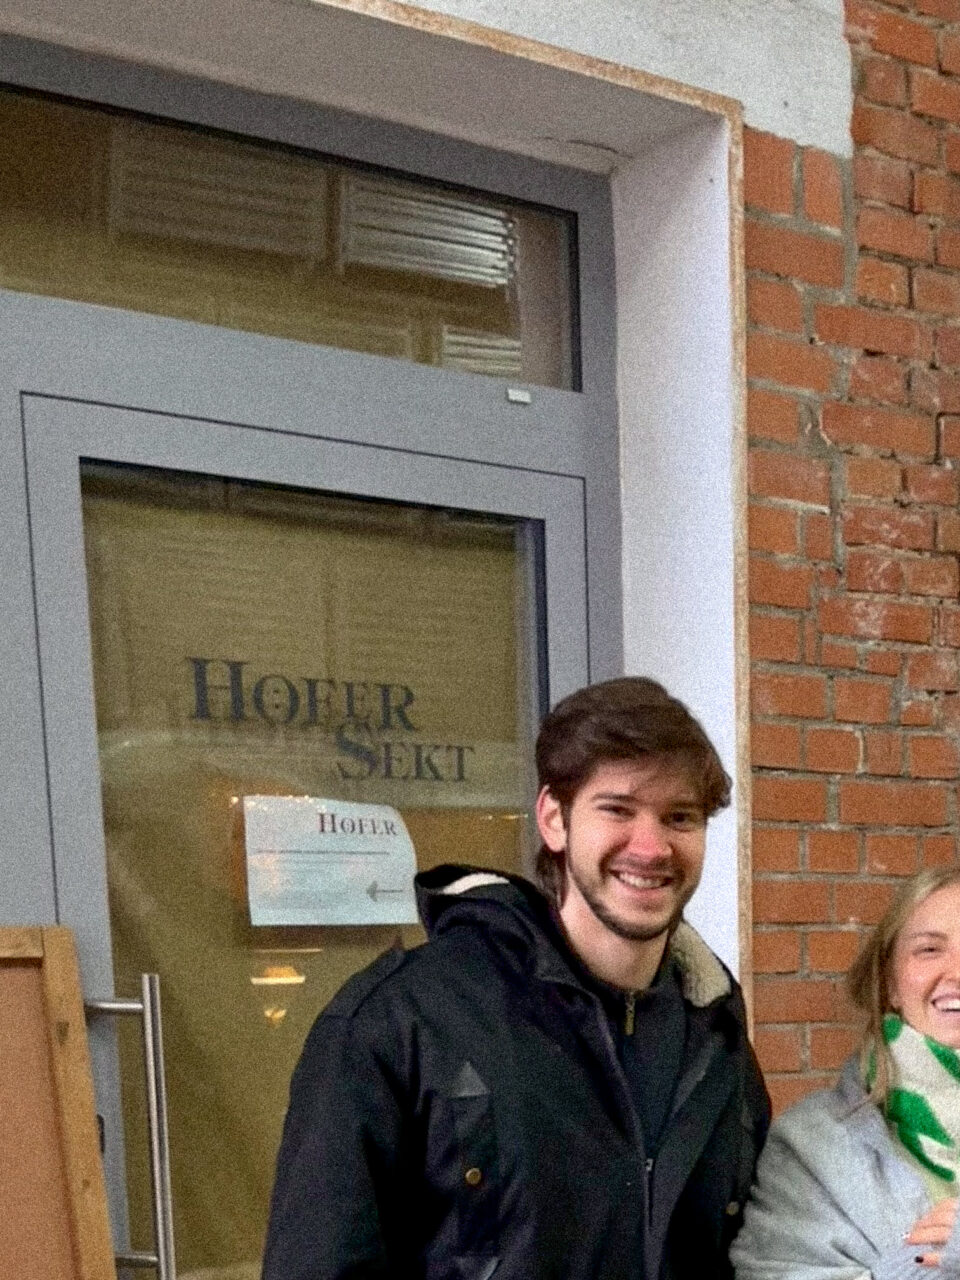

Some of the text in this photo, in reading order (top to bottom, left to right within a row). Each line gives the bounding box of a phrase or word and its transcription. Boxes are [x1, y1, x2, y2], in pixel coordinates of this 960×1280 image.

[188, 656, 418, 732] HOFER
[335, 720, 474, 781] SEKT
[318, 813, 399, 836] HOFER
